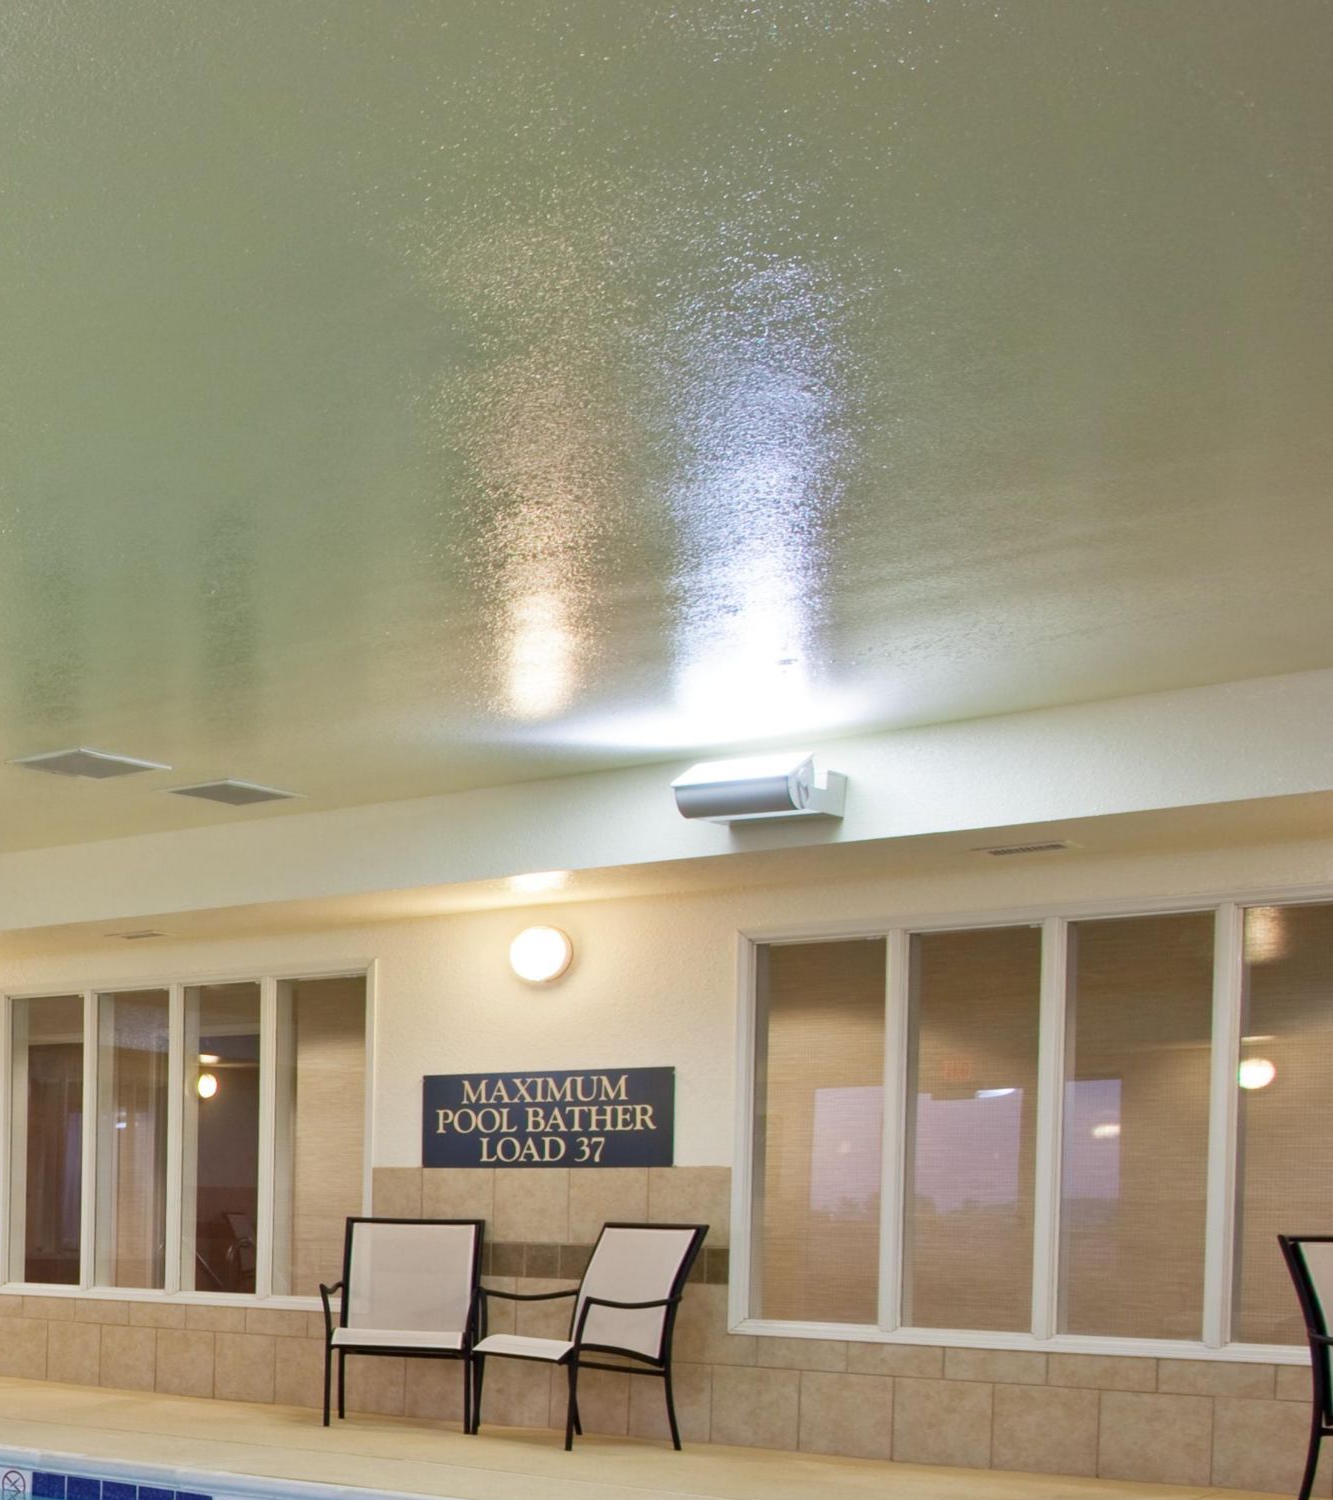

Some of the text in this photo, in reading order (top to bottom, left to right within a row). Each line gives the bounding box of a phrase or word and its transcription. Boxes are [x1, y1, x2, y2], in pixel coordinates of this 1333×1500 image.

[461, 1075, 629, 1104] MAXIMUM
[436, 1104, 657, 1134] POOL BATHER
[479, 1137, 606, 1162] LOAD 37
